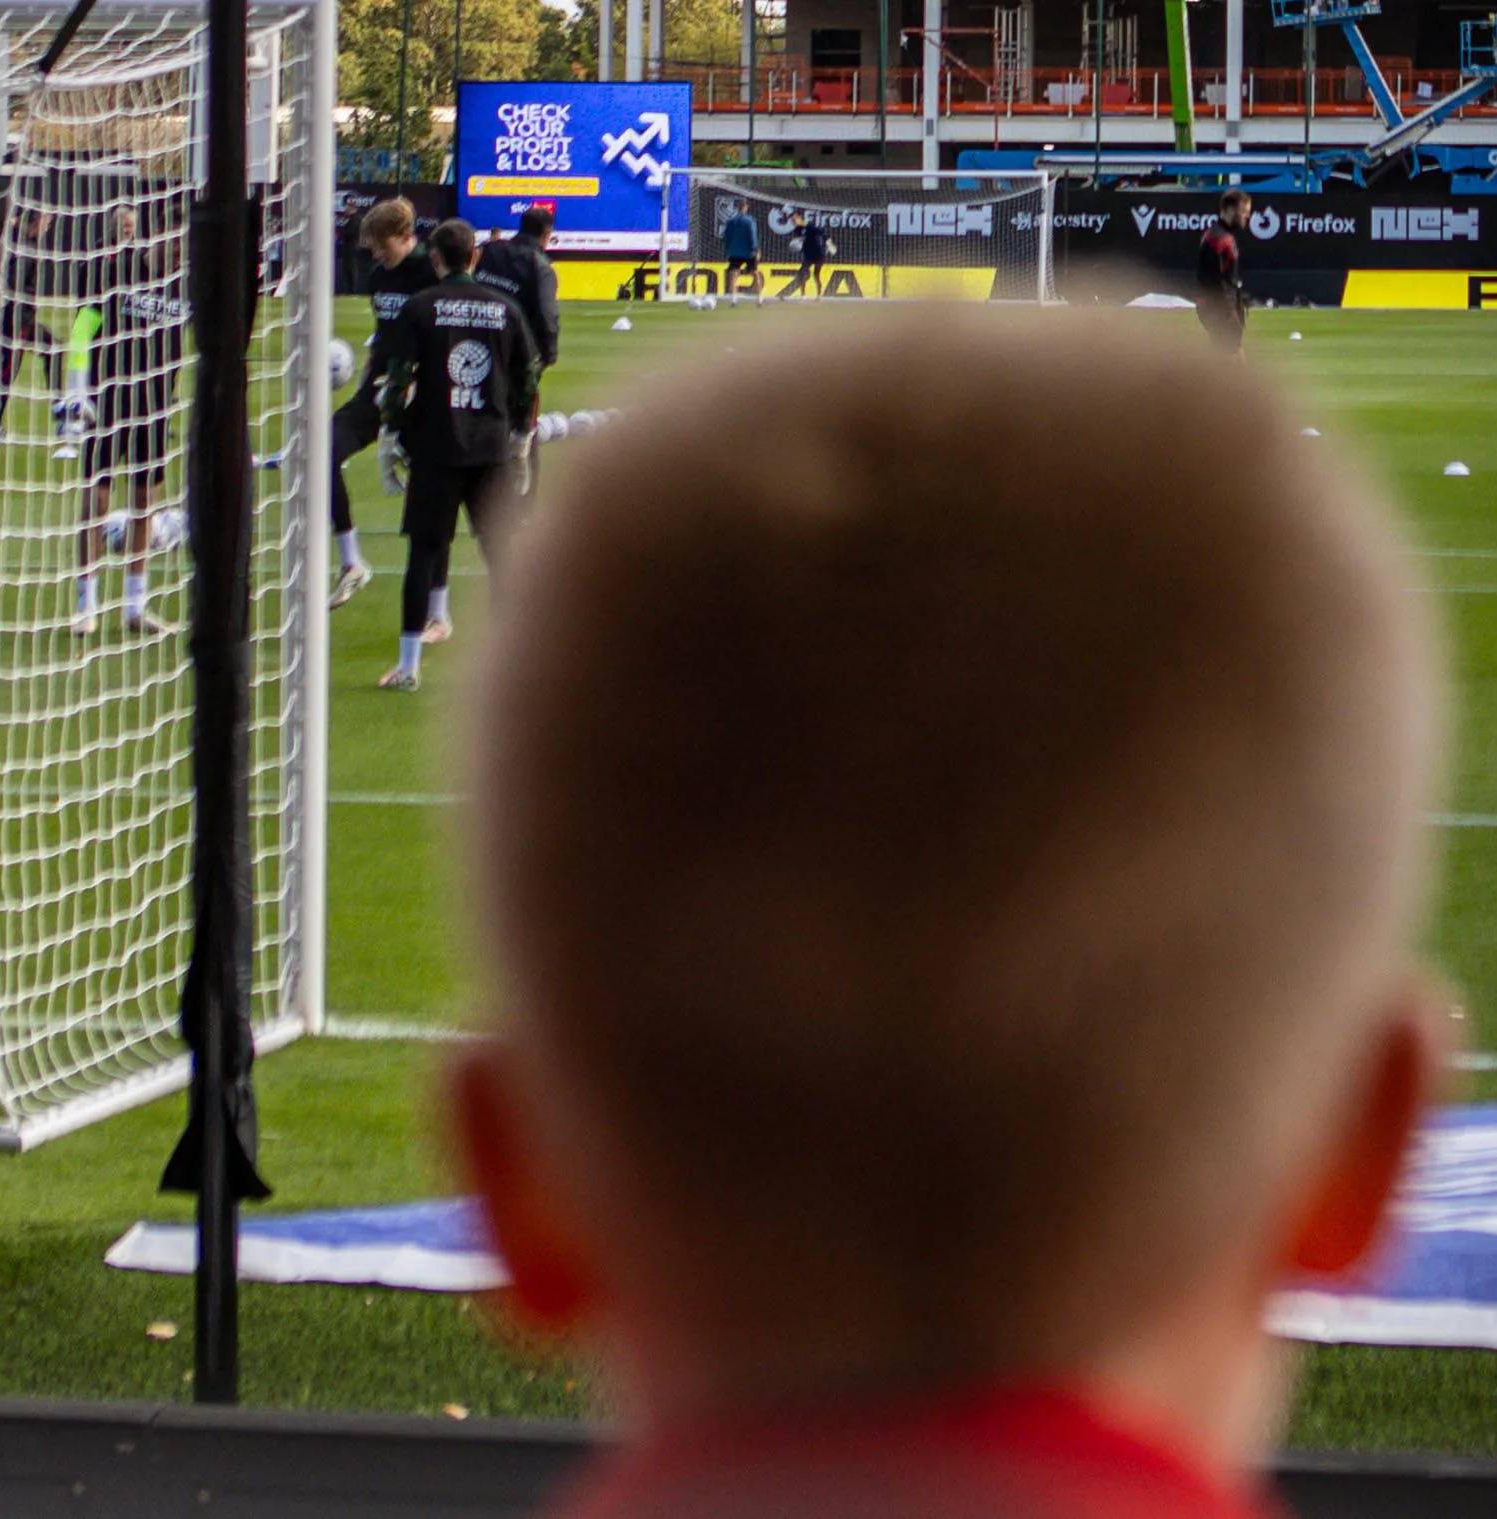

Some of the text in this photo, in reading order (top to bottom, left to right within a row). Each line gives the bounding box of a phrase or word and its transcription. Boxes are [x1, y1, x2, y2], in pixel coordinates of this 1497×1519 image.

[497, 102, 572, 122] CHECK
[506, 120, 565, 138] YOUR
[495, 136, 573, 155] PROFIT
[496, 153, 572, 172] & LOSS
[803, 210, 873, 229] Firefox
[1286, 213, 1356, 233] Firefox
[434, 300, 506, 319] TOGETHER
[450, 387, 485, 409] EFL
